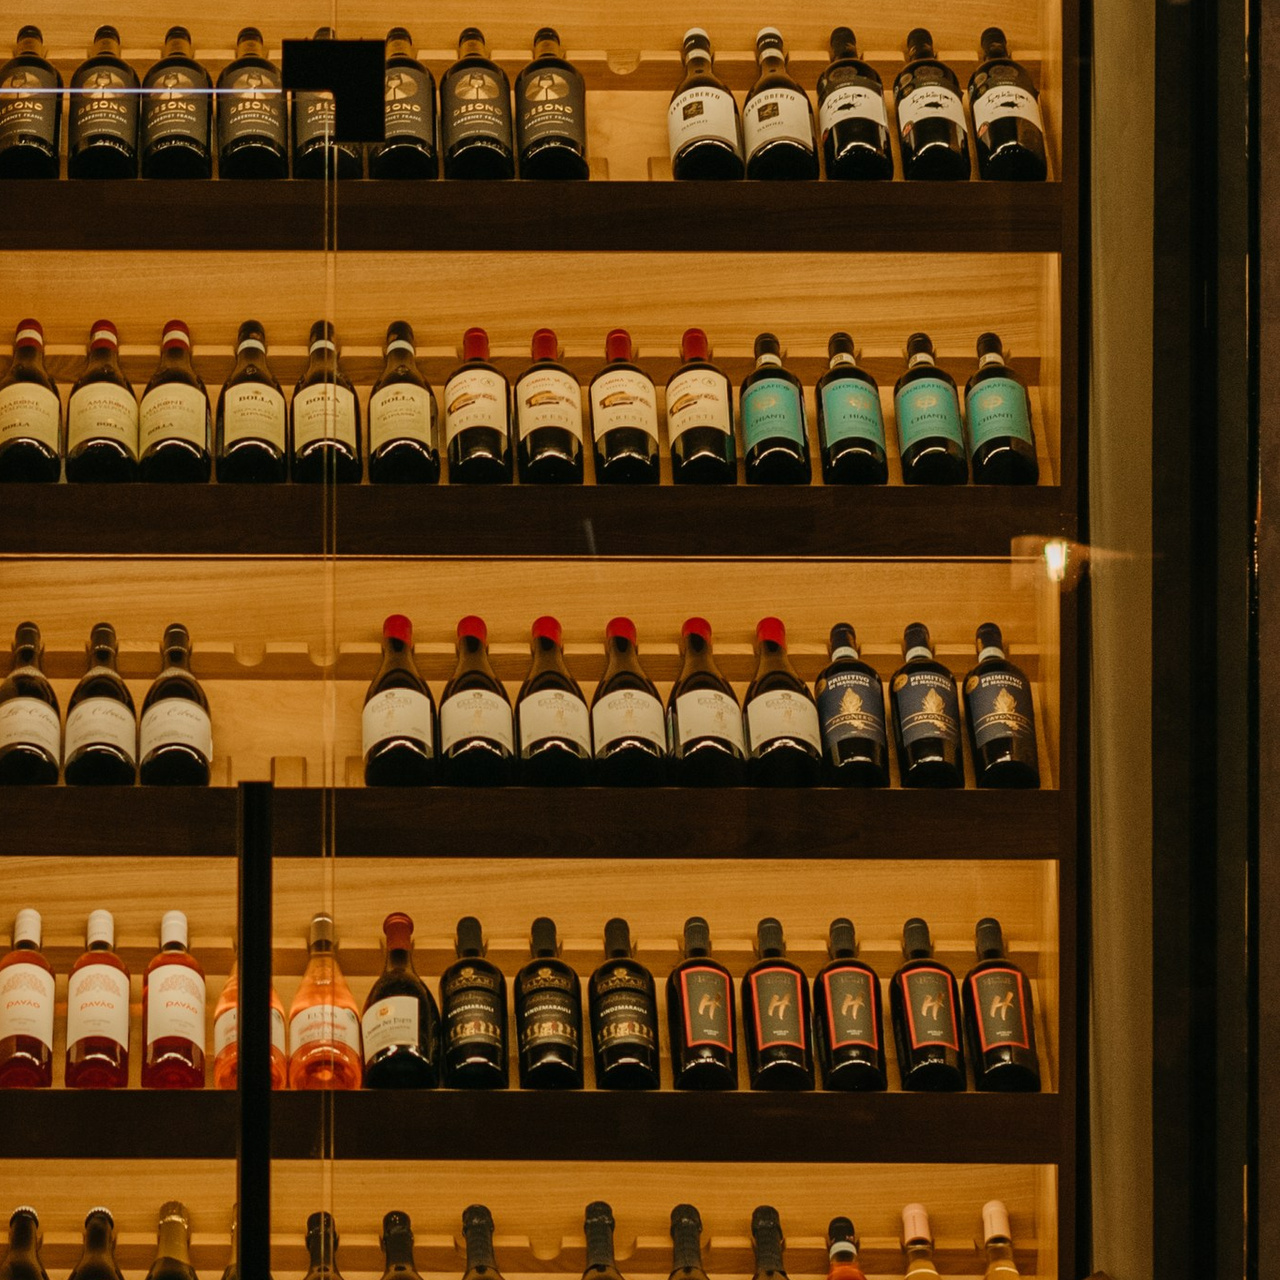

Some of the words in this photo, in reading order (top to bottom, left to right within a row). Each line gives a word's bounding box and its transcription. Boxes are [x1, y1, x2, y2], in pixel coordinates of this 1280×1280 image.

[78, 101, 127, 116] DESONO
[149, 102, 196, 117] DESONO
[230, 101, 279, 116] DESONO
[385, 103, 421, 112] SONO
[453, 103, 502, 116] DESONO
[670, 95, 687, 115] FABIO
[689, 92, 721, 100] OBERTO
[745, 97, 762, 117] FABIO
[764, 93, 795, 101] OBERTO
[23, 113, 44, 121] FRANC
[525, 103, 573, 120] DESONO
[78, 114, 107, 125] CABERNET
[108, 113, 128, 124] FRANC
[148, 114, 176, 128] CABERNET
[177, 114, 196, 122] FRANC
[230, 114, 260, 124] CABERNET
[261, 114, 279, 126] FRANC
[401, 114, 421, 122] FRANC
[453, 114, 483, 126] CABERNET
[484, 116, 503, 126] FRANC
[525, 115, 554, 130] CABERNET
[555, 114, 574, 123] FRANC
[239, 396, 273, 406] BOLLA
[305, 396, 340, 405] BOLLA
[380, 396, 415, 407] BOLLA
[87, 401, 131, 414] AMARONE
[143, 399, 183, 418] AMARONE
[535, 414, 574, 425] ARESTI
[608, 414, 648, 425] ARESTI
[751, 414, 786, 428] CHIANTI
[842, 414, 878, 427] CHIANTI
[910, 413, 947, 425] CHIANTI
[978, 413, 1014, 427] CHIANTI
[2, 422, 30, 432] BOLLA
[96, 421, 125, 432] BOLLA
[147, 422, 174, 436] BOLLA
[827, 674, 870, 686] PRIMITIVO
[910, 674, 951, 687] PRIMITIVO
[918, 680, 951, 691] MANDURIA
[980, 674, 1023, 685] PRIMITIVO
[990, 680, 1023, 690] MANDURIA
[448, 1004, 495, 1018] KINDZMARAULI
[524, 1005, 572, 1017] KINDZMARAULI
[600, 1005, 648, 1017] KINDZMARAULI
